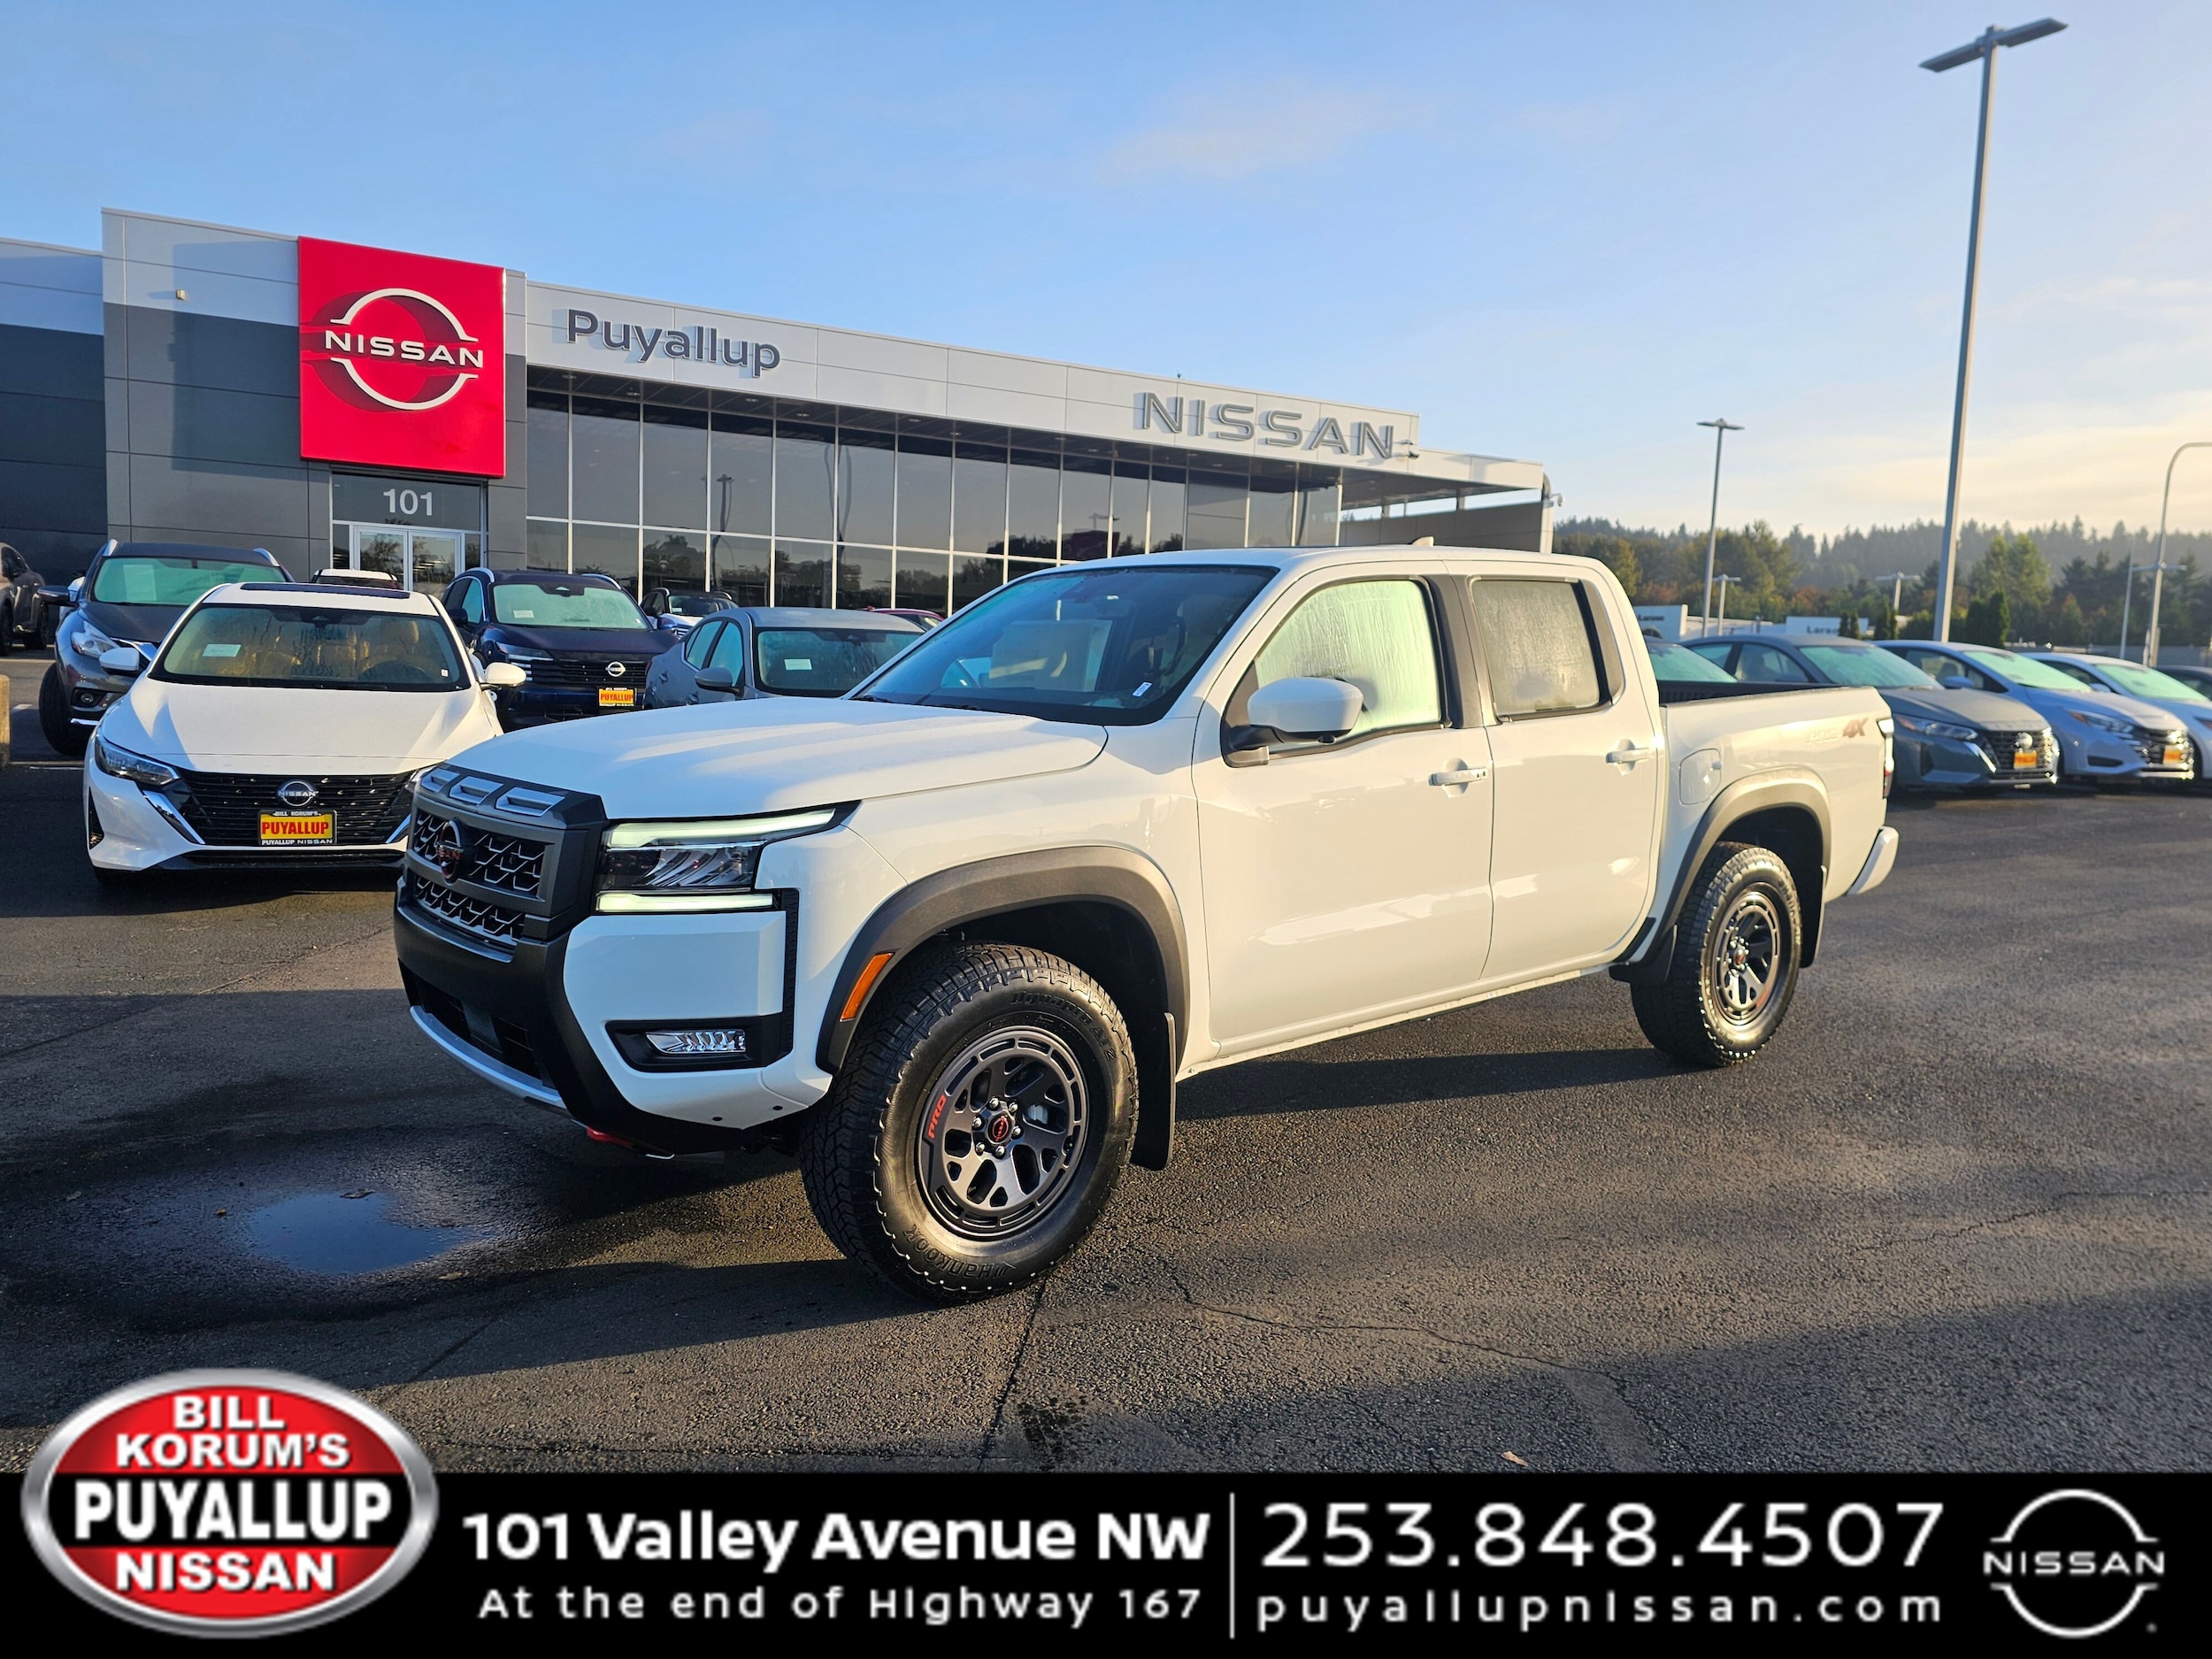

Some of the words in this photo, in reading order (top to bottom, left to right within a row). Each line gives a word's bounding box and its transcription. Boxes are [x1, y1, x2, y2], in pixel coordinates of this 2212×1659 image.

[324, 328, 484, 369] NISSAN
[565, 308, 781, 378] Puyallup
[1142, 391, 1395, 460] NISSAN
[382, 488, 434, 516] 101
[601, 693, 634, 702] PUYALLUP
[261, 821, 329, 834] PUYALLUP
[927, 1094, 947, 1139] PRO
